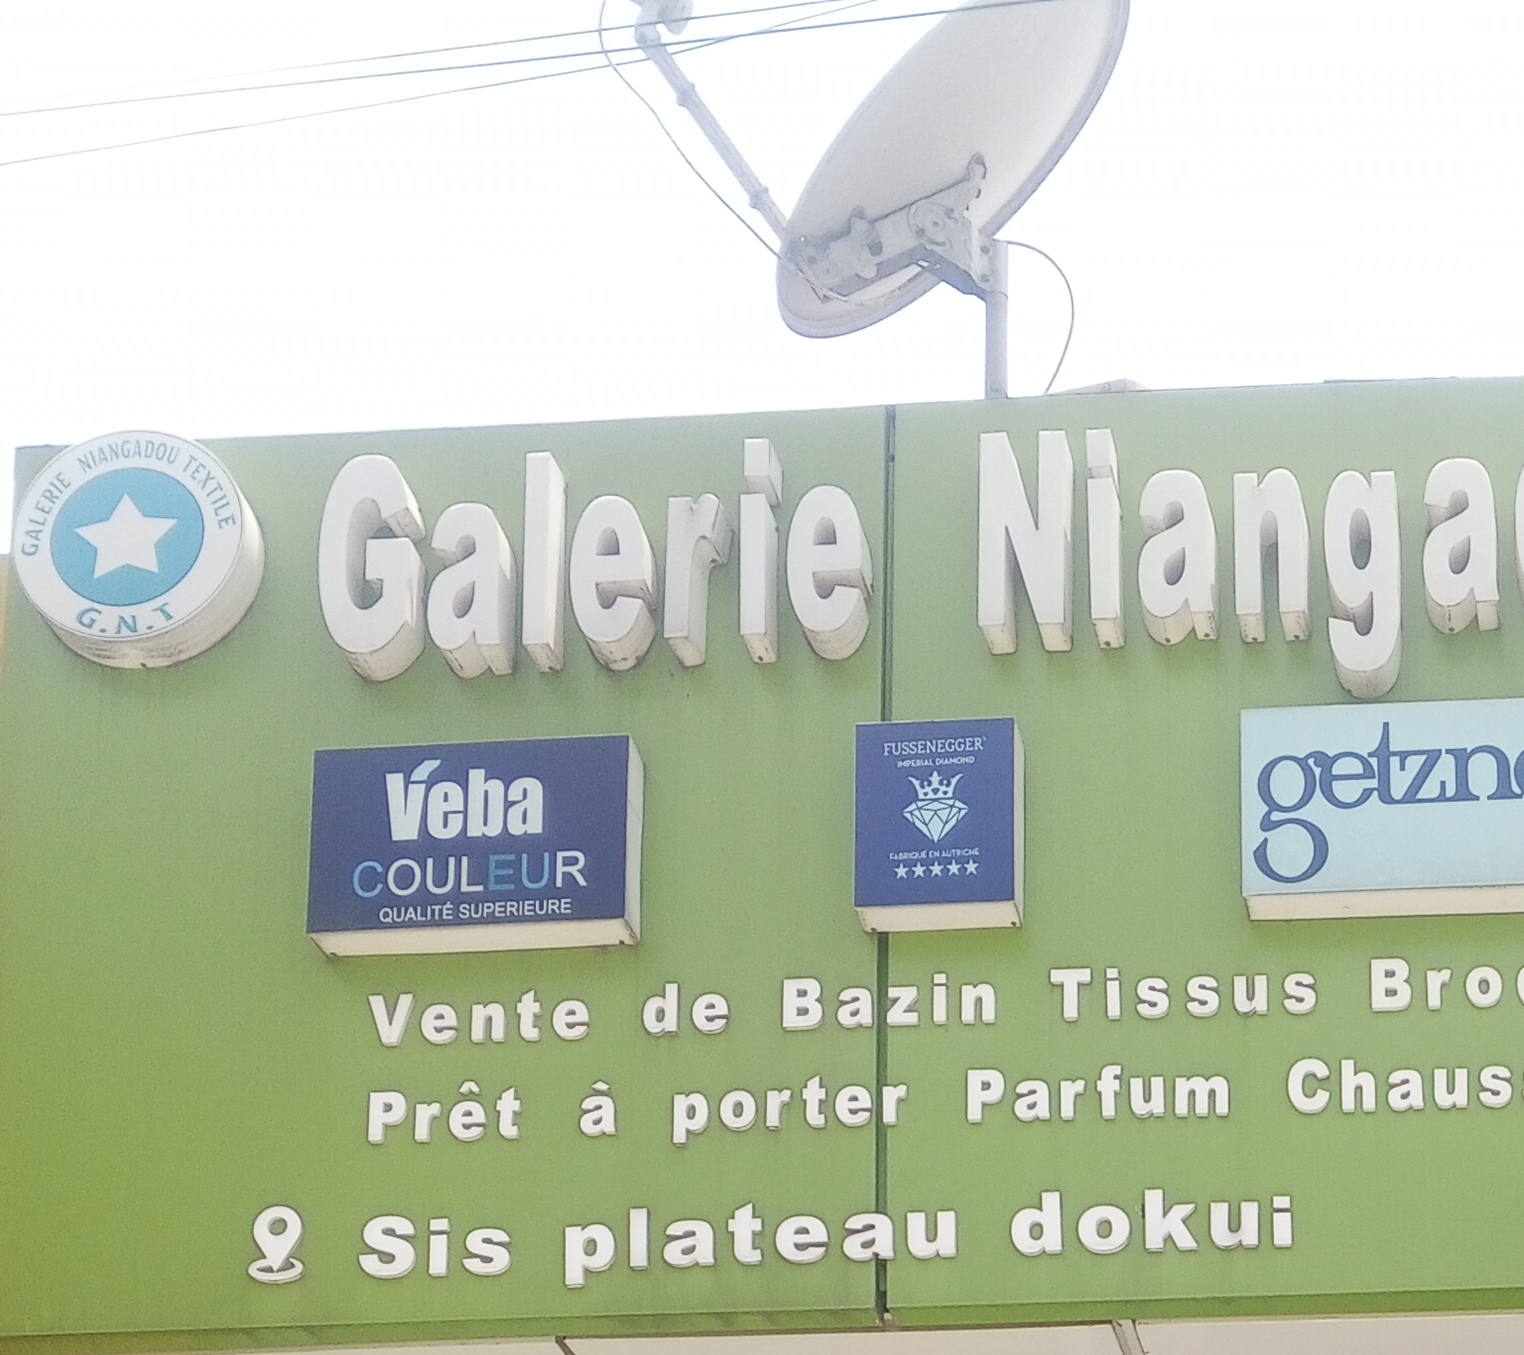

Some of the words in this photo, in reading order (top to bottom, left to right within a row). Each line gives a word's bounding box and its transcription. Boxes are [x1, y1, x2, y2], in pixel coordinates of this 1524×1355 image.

[21, 471, 72, 557] GALERIE
[77, 439, 182, 474] NIANGADOU
[182, 454, 236, 530] TEXTILE
[318, 438, 872, 672] Galerie
[935, 756, 975, 766] DIAMOND
[352, 850, 588, 898] COULEUR
[379, 902, 453, 923] QUALITÉ
[458, 899, 572, 918] SUPERIEURE
[368, 988, 590, 1047] Vente
[642, 982, 731, 1036] de
[781, 974, 998, 1032] Bazin
[1050, 966, 1318, 1022] Tissus
[367, 1080, 521, 1144] Prêt
[672, 1075, 908, 1146] porter
[966, 1064, 1231, 1123] Parfum
[358, 1213, 512, 1280] Sis
[563, 1202, 958, 1288] plateau
[1010, 1188, 1295, 1257] dokui
